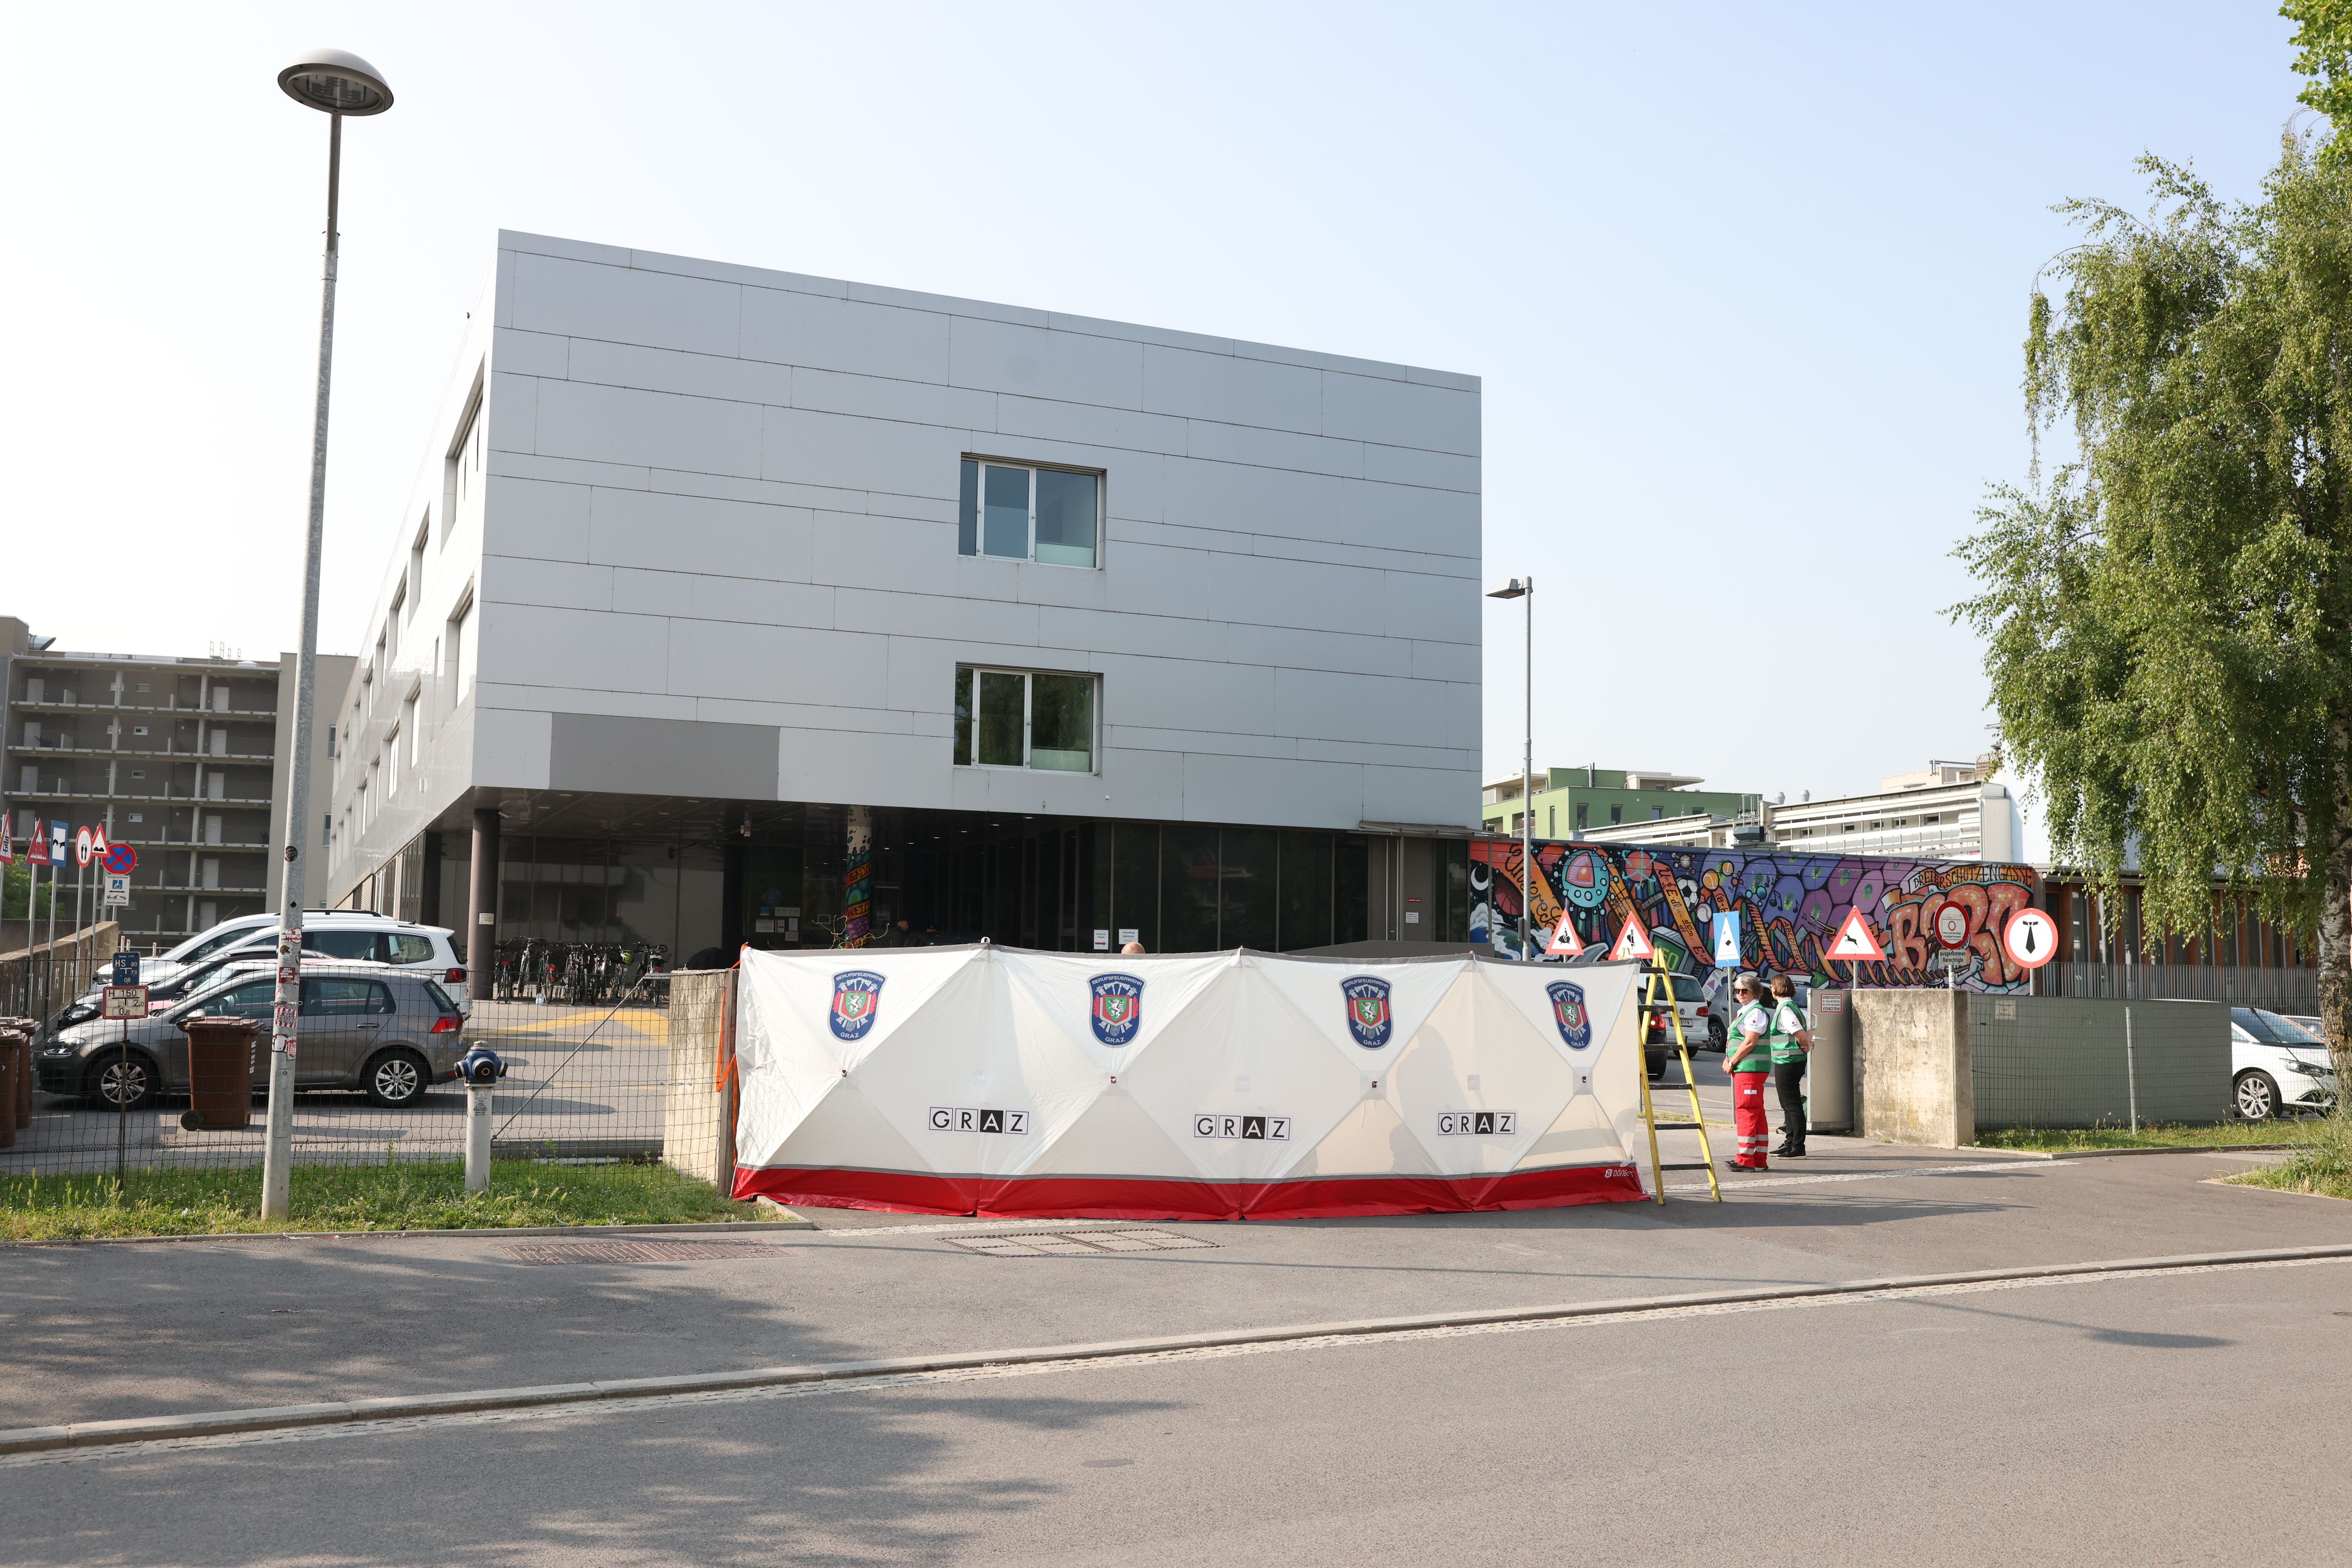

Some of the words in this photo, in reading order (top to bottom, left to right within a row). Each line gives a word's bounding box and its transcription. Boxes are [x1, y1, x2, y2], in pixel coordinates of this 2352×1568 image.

[836, 972, 884, 982] BERUFSFEUERWEHR
[1091, 976, 1142, 986] BERUFSFEUERWEHR
[1343, 978, 1389, 989] BERUFSFEUERWEHR
[1548, 984, 1582, 994] BERUFSFEUERWEHR
[932, 1111, 1024, 1132] GRAZ
[1440, 1115, 1511, 1133] GRAZ
[1197, 1118, 1285, 1138] GRAZ
